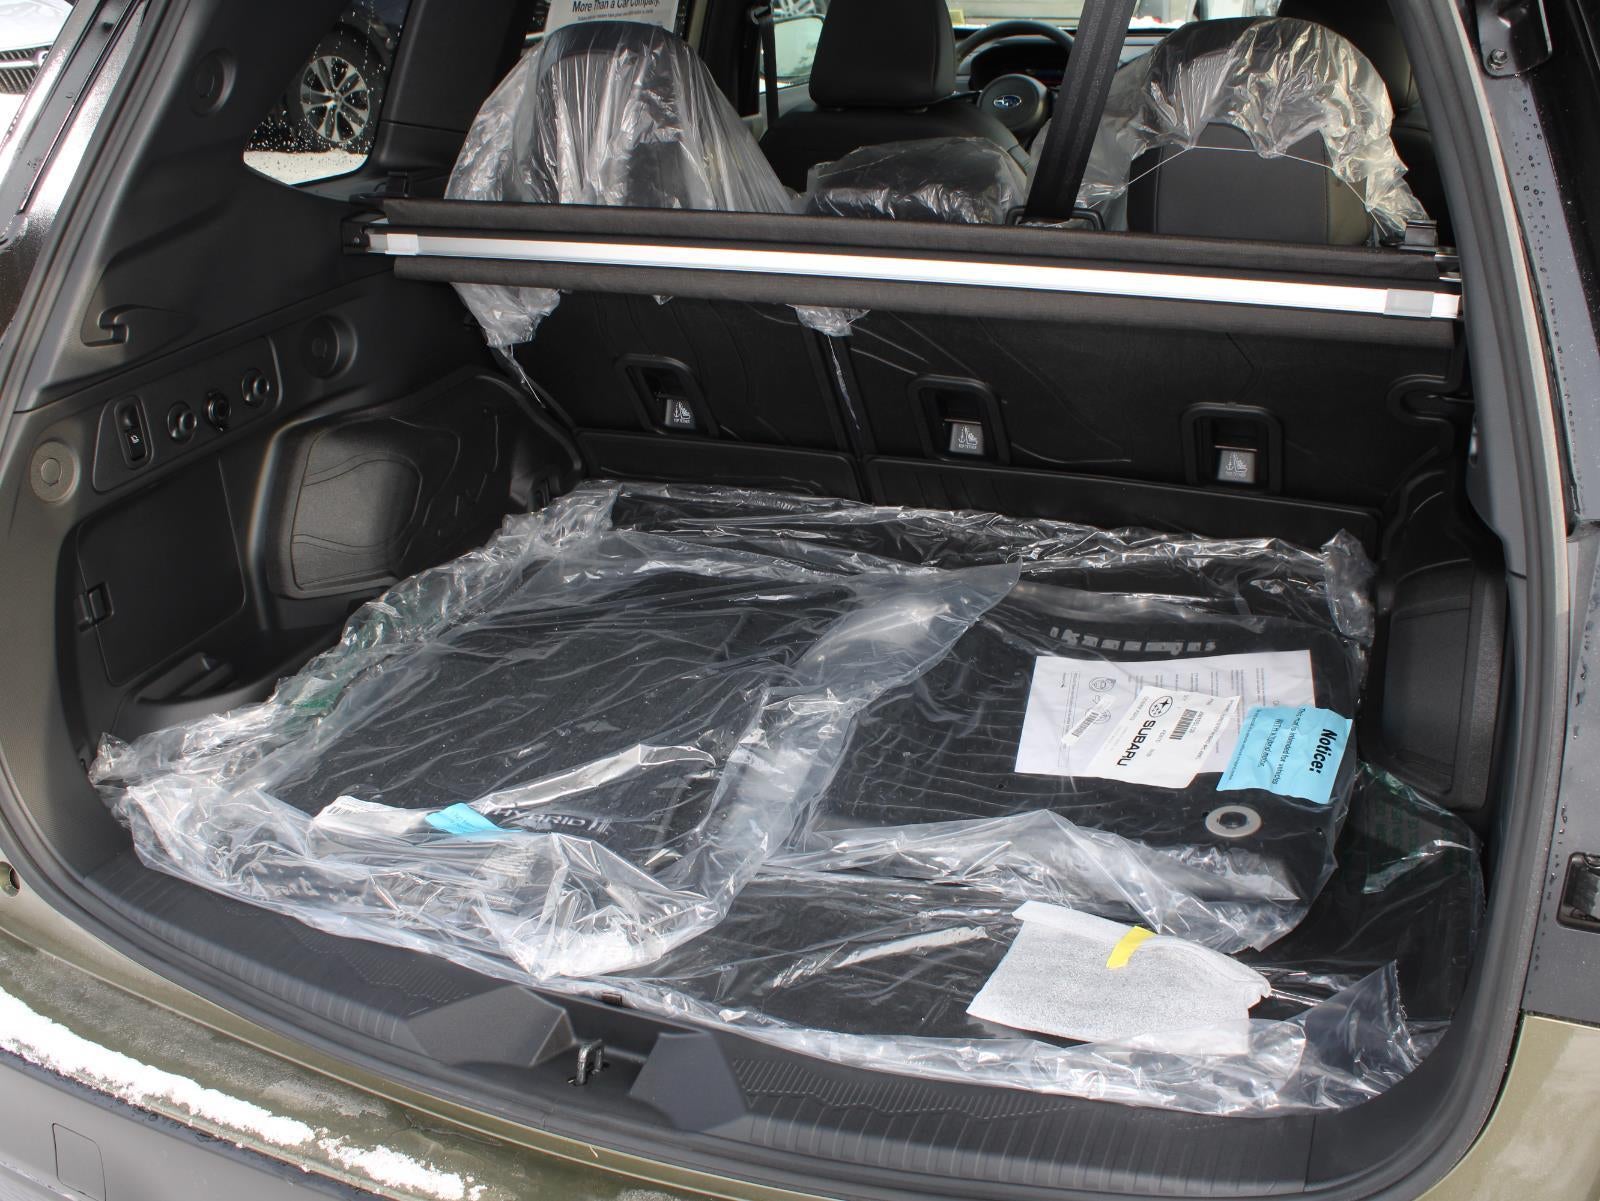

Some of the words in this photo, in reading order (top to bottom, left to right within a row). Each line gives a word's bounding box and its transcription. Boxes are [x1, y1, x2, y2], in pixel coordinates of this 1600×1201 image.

[572, 0, 593, 12] More
[594, 0, 609, 10] Than
[617, 0, 630, 8] Car
[1116, 720, 1156, 766] SUBARU
[1282, 731, 1296, 754] intended
[1309, 728, 1338, 774] Notice:
[493, 808, 586, 826] HYBRID
